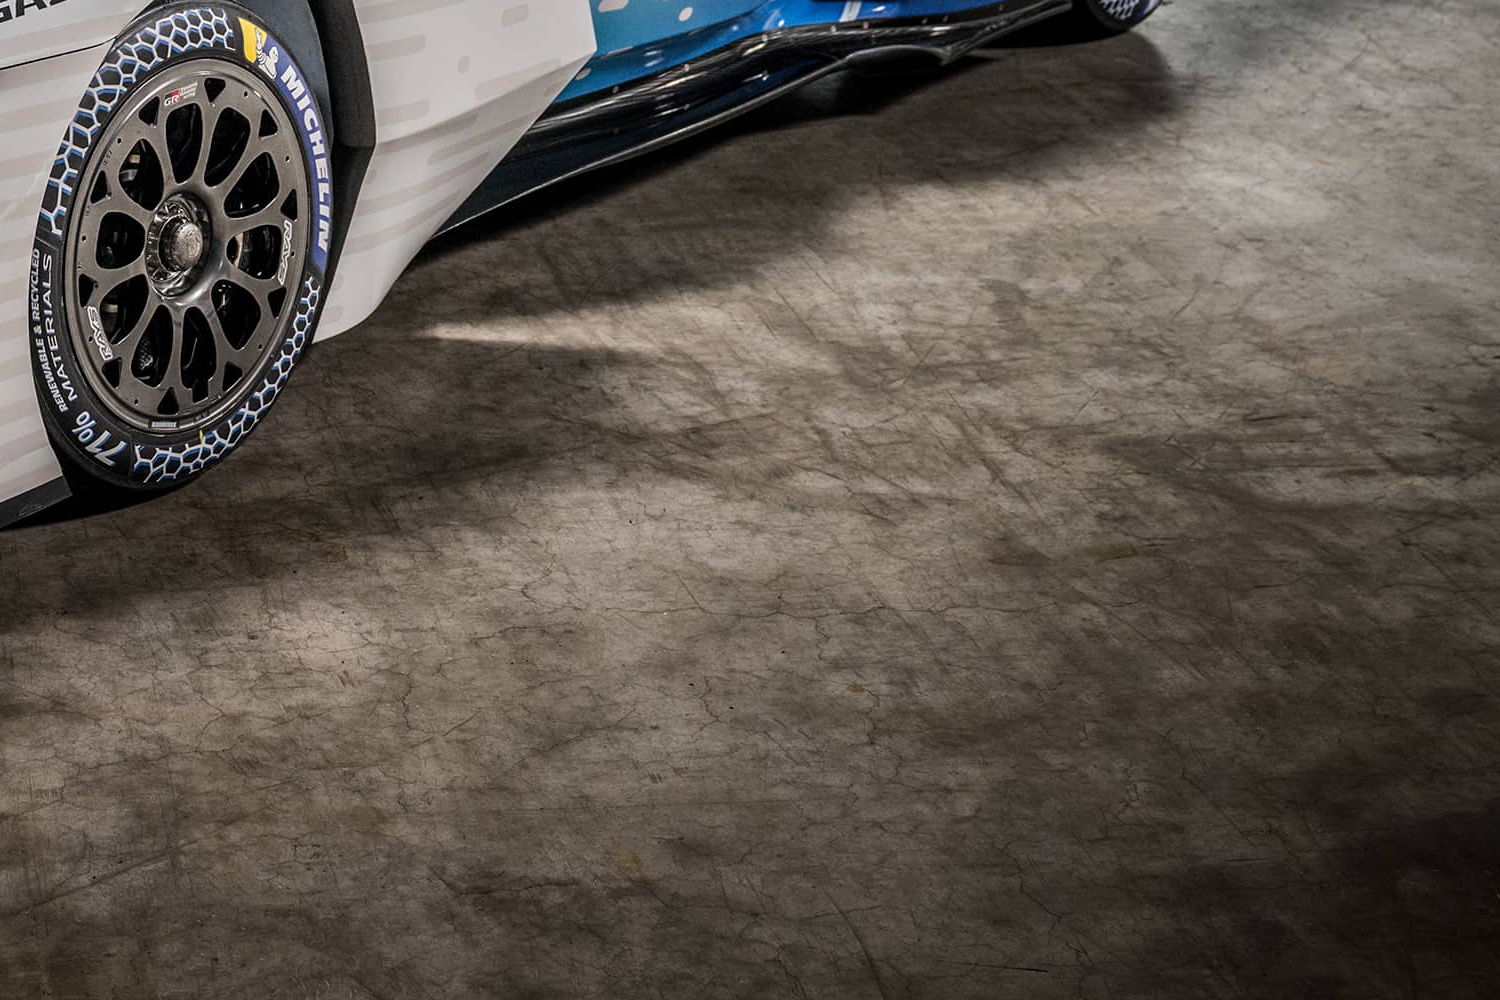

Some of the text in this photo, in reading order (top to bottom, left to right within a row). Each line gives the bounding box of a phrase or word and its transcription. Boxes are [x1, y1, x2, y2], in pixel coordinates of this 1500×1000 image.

[280, 65, 330, 252] MICHELIN
[277, 220, 293, 286] RAYS
[30, 248, 68, 413] RENEWABLE & RECYCLED
[42, 253, 78, 402] MATERIALS
[87, 306, 113, 361] RAYS
[71, 411, 129, 467] 71%
